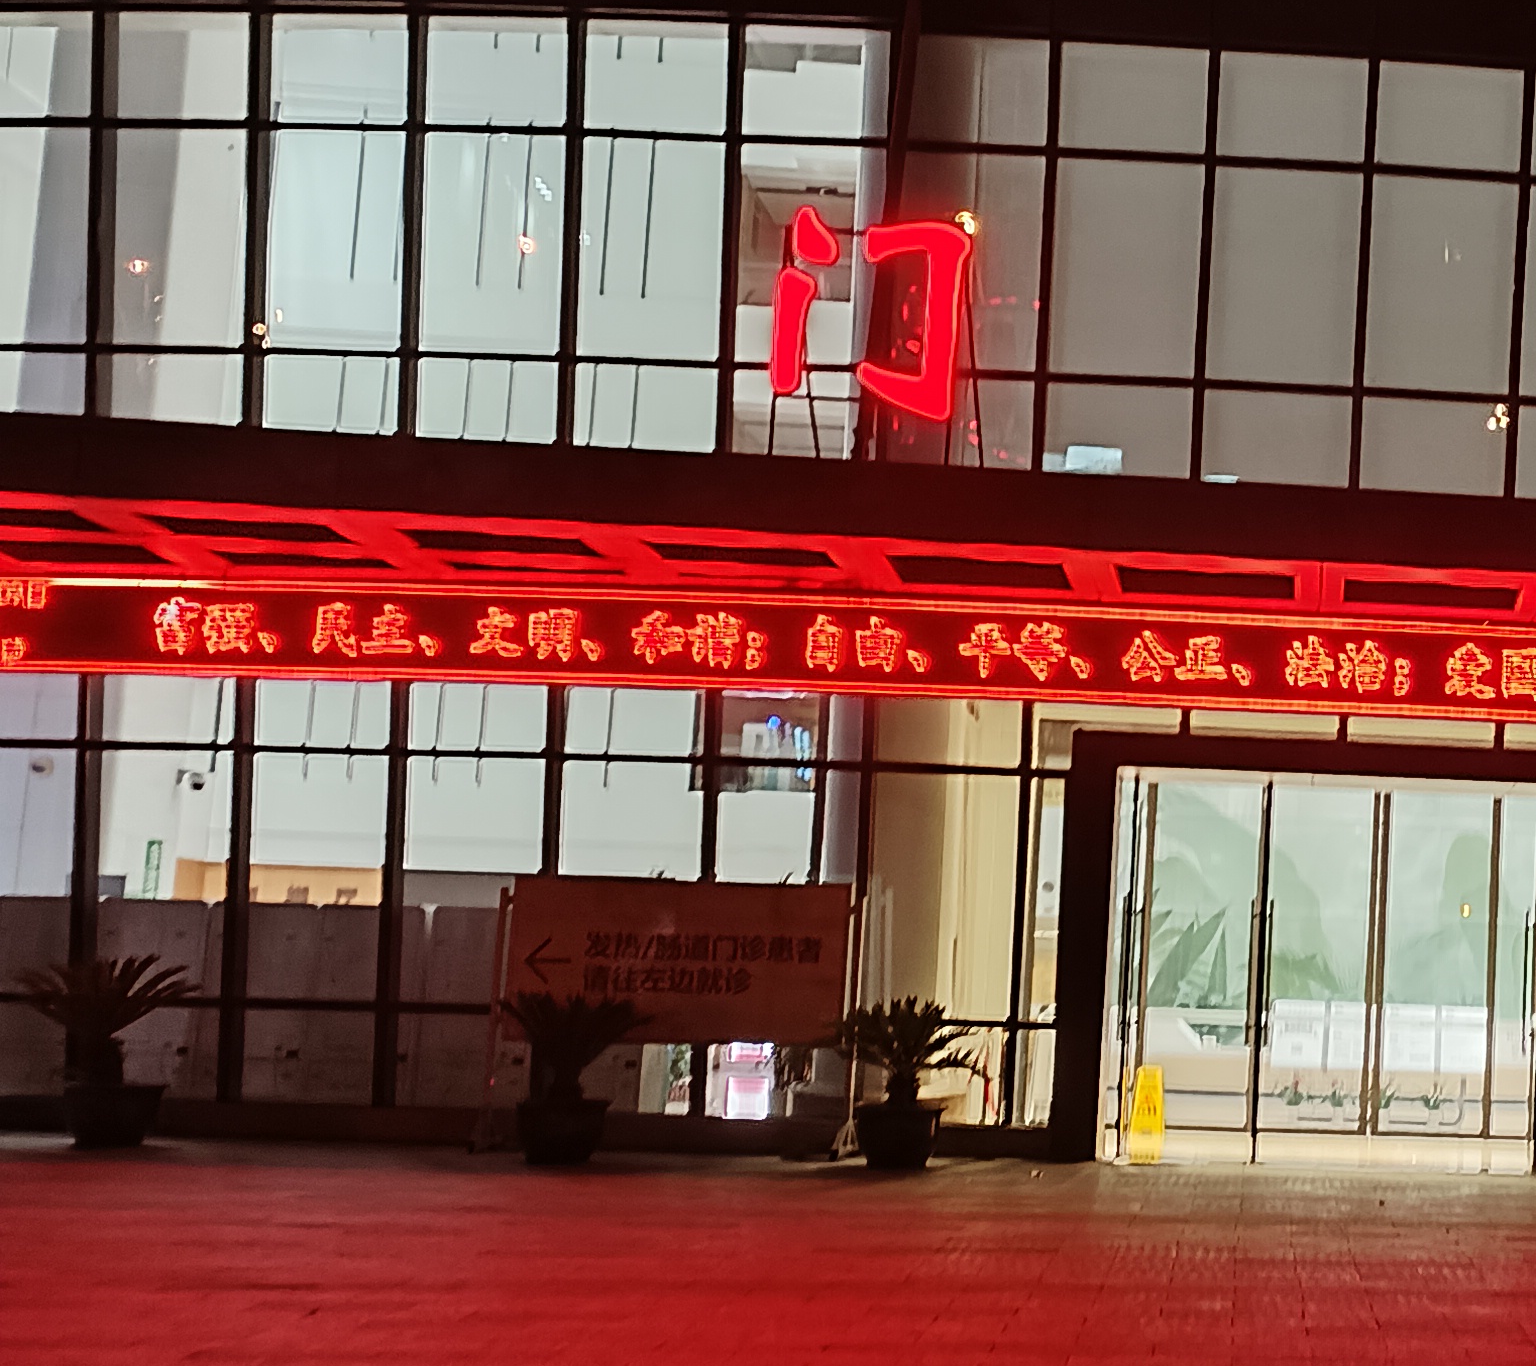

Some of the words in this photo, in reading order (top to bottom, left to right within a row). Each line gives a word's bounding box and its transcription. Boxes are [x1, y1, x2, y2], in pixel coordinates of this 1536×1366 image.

[771, 205, 972, 422] 门
[582, 963, 753, 996] 请往左边就诊
